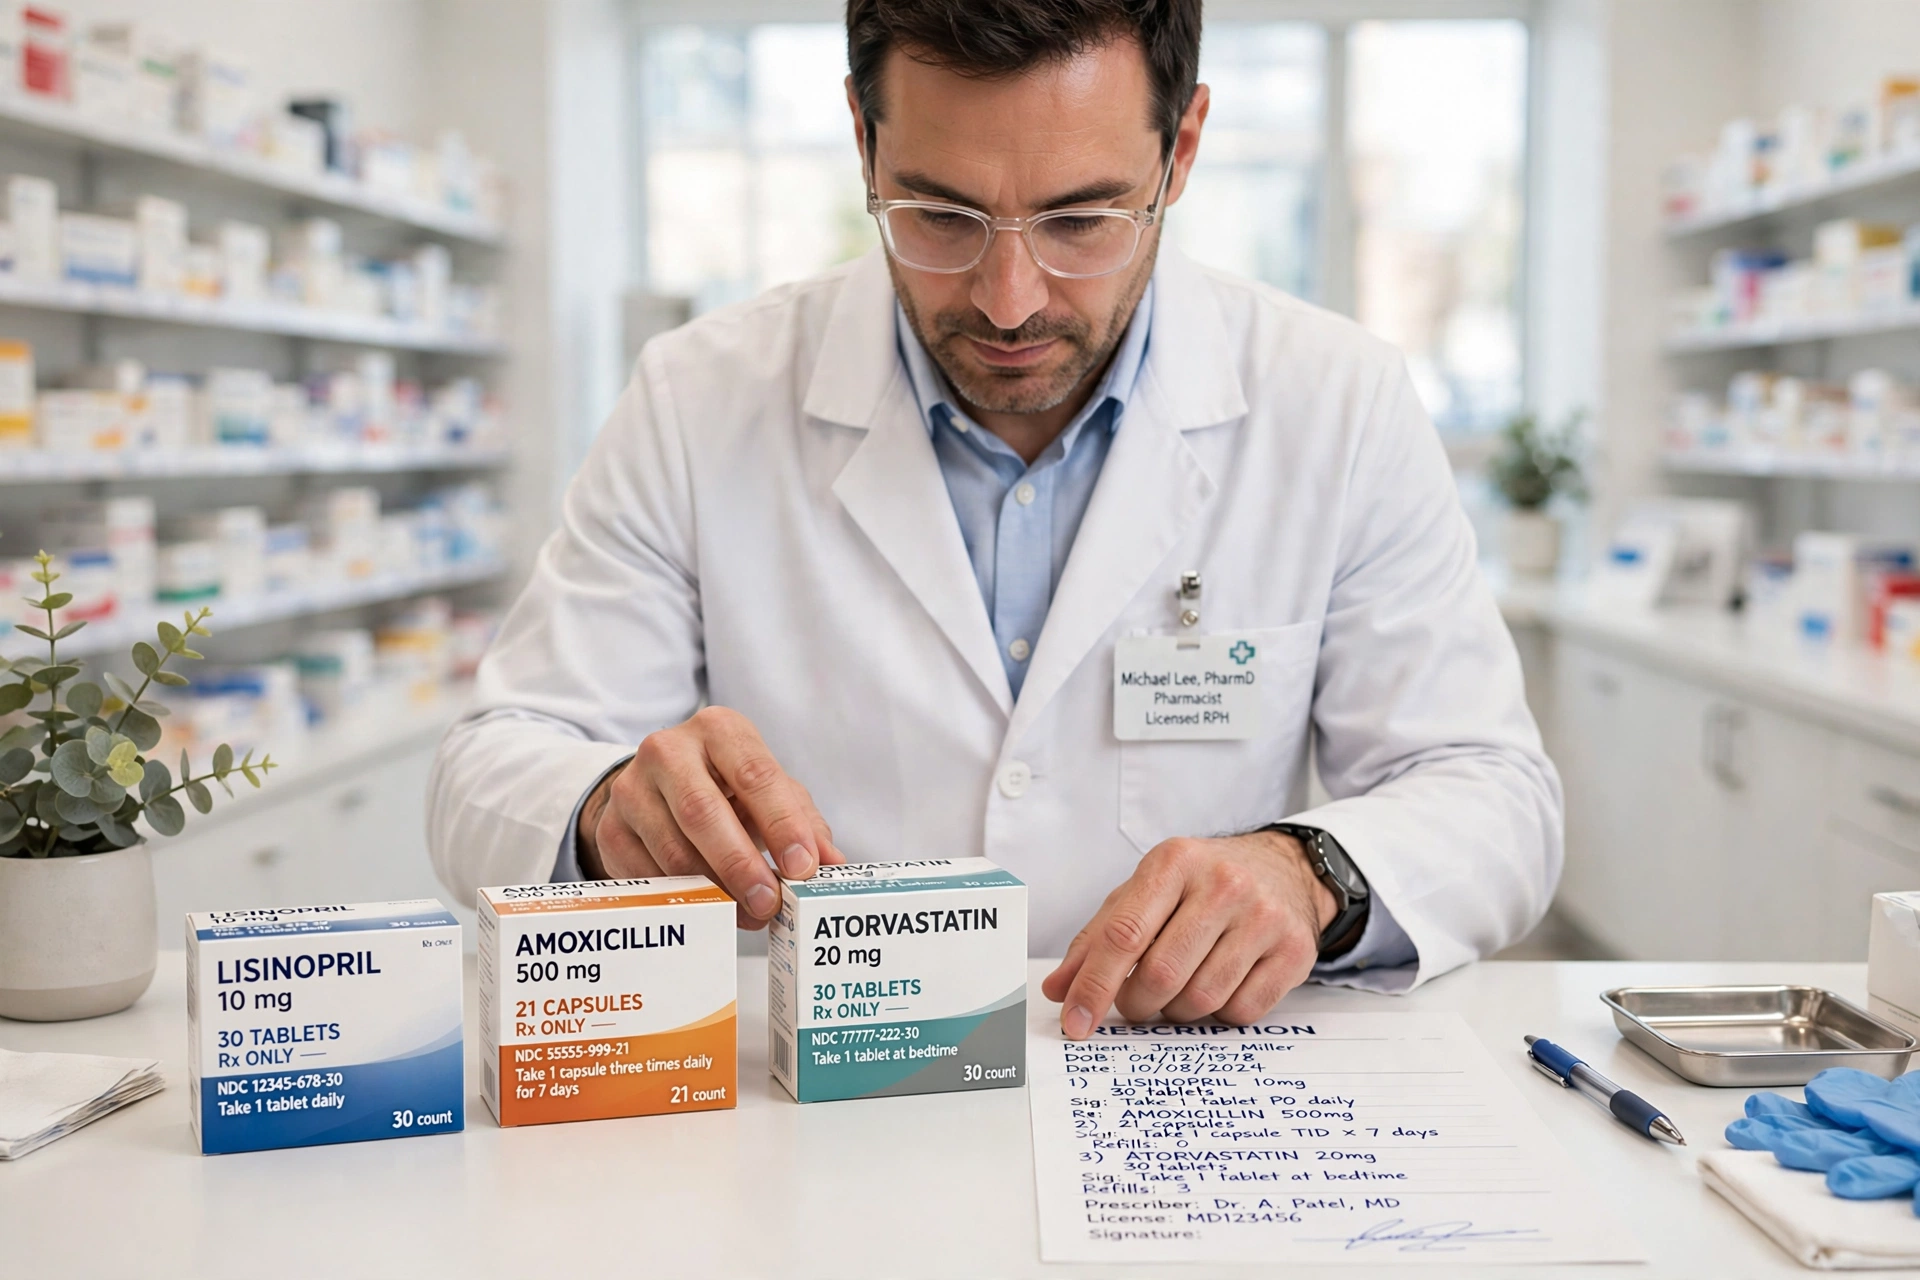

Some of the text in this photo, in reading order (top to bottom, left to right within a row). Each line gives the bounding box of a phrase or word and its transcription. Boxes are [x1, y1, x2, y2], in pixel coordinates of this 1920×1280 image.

[1121, 671, 1255, 686] Michael Lee, PharmD
[1154, 692, 1222, 705] Pharmacist
[1146, 711, 1230, 725] Licensed RPH
[818, 859, 952, 872] ORVASTATIN
[502, 879, 651, 894] AMOXICILLIN
[505, 889, 583, 900] 500 mg
[209, 905, 355, 919] LISINOPRIL
[813, 907, 998, 940] ATORVASTATIN
[515, 923, 685, 957] AMOXICILLIN
[814, 946, 882, 968] 20 mg
[217, 950, 382, 985] LISINOPRIL
[516, 961, 601, 983] 500 mg
[813, 979, 922, 1001] 30 TABLETS
[217, 990, 293, 1013] 10 mg
[515, 993, 643, 1018] 21 CAPSULES
[813, 1002, 881, 1020] Rx ONLY
[217, 1022, 341, 1048] 30 TABLETS
[516, 1018, 586, 1037] Rx ONLY
[1061, 1025, 1316, 1036] RESCRIPTION
[812, 1026, 920, 1046] NDC 77777-222-30
[515, 1042, 630, 1062] NDC 55555-999-21
[812, 1043, 958, 1066] Take 1 tablet at bedtime
[1063, 1043, 1296, 1052] Patient: Jennifer Miller
[218, 1048, 295, 1068] Rx ONLY
[1129, 1052, 1256, 1064] 04/12/1978
[515, 1054, 714, 1082] Take 1 capsule three times daily
[963, 1065, 1017, 1082] 30 count
[1066, 1063, 1266, 1075] Date: 10/08/2024
[217, 1072, 344, 1096] NDC 12345-678-30
[515, 1082, 580, 1099] for 7 days
[1069, 1077, 1307, 1090] 1) LISINOPRIL 10mg
[670, 1086, 726, 1103] 21 count
[1110, 1086, 1215, 1097] 30 tablets
[217, 1092, 346, 1117] Take 1 tablet daily
[1070, 1096, 1355, 1109] Sig: Take 1 tablet PO daily
[392, 1109, 453, 1129] 30 count
[1121, 1109, 1265, 1120] AMOXICILLIN
[1281, 1109, 1354, 1122] 500mg
[1118, 1119, 1139, 1129] 21
[1151, 1119, 1236, 1130] capsules
[1139, 1127, 1185, 1139] Take
[1193, 1129, 1199, 1139] 1
[1210, 1128, 1282, 1141] capsule
[1290, 1128, 1331, 1138] TID
[1365, 1128, 1380, 1138] 7
[1392, 1127, 1439, 1140] days
[1092, 1138, 1159, 1149] Refills:
[1079, 1150, 1377, 1164] 3) ATORVASTATIN 20mg
[1123, 1161, 1229, 1172] 30 tablets
[1081, 1169, 1409, 1184] Sig: Take 1 tablet at bedtime
[1083, 1183, 1192, 1195] Refills: 3
[1085, 1197, 1401, 1211] Prescriber: Dr. A. Patel, MD
[1086, 1212, 1303, 1225] License: MD123456
[1088, 1229, 1203, 1242] Signature:
